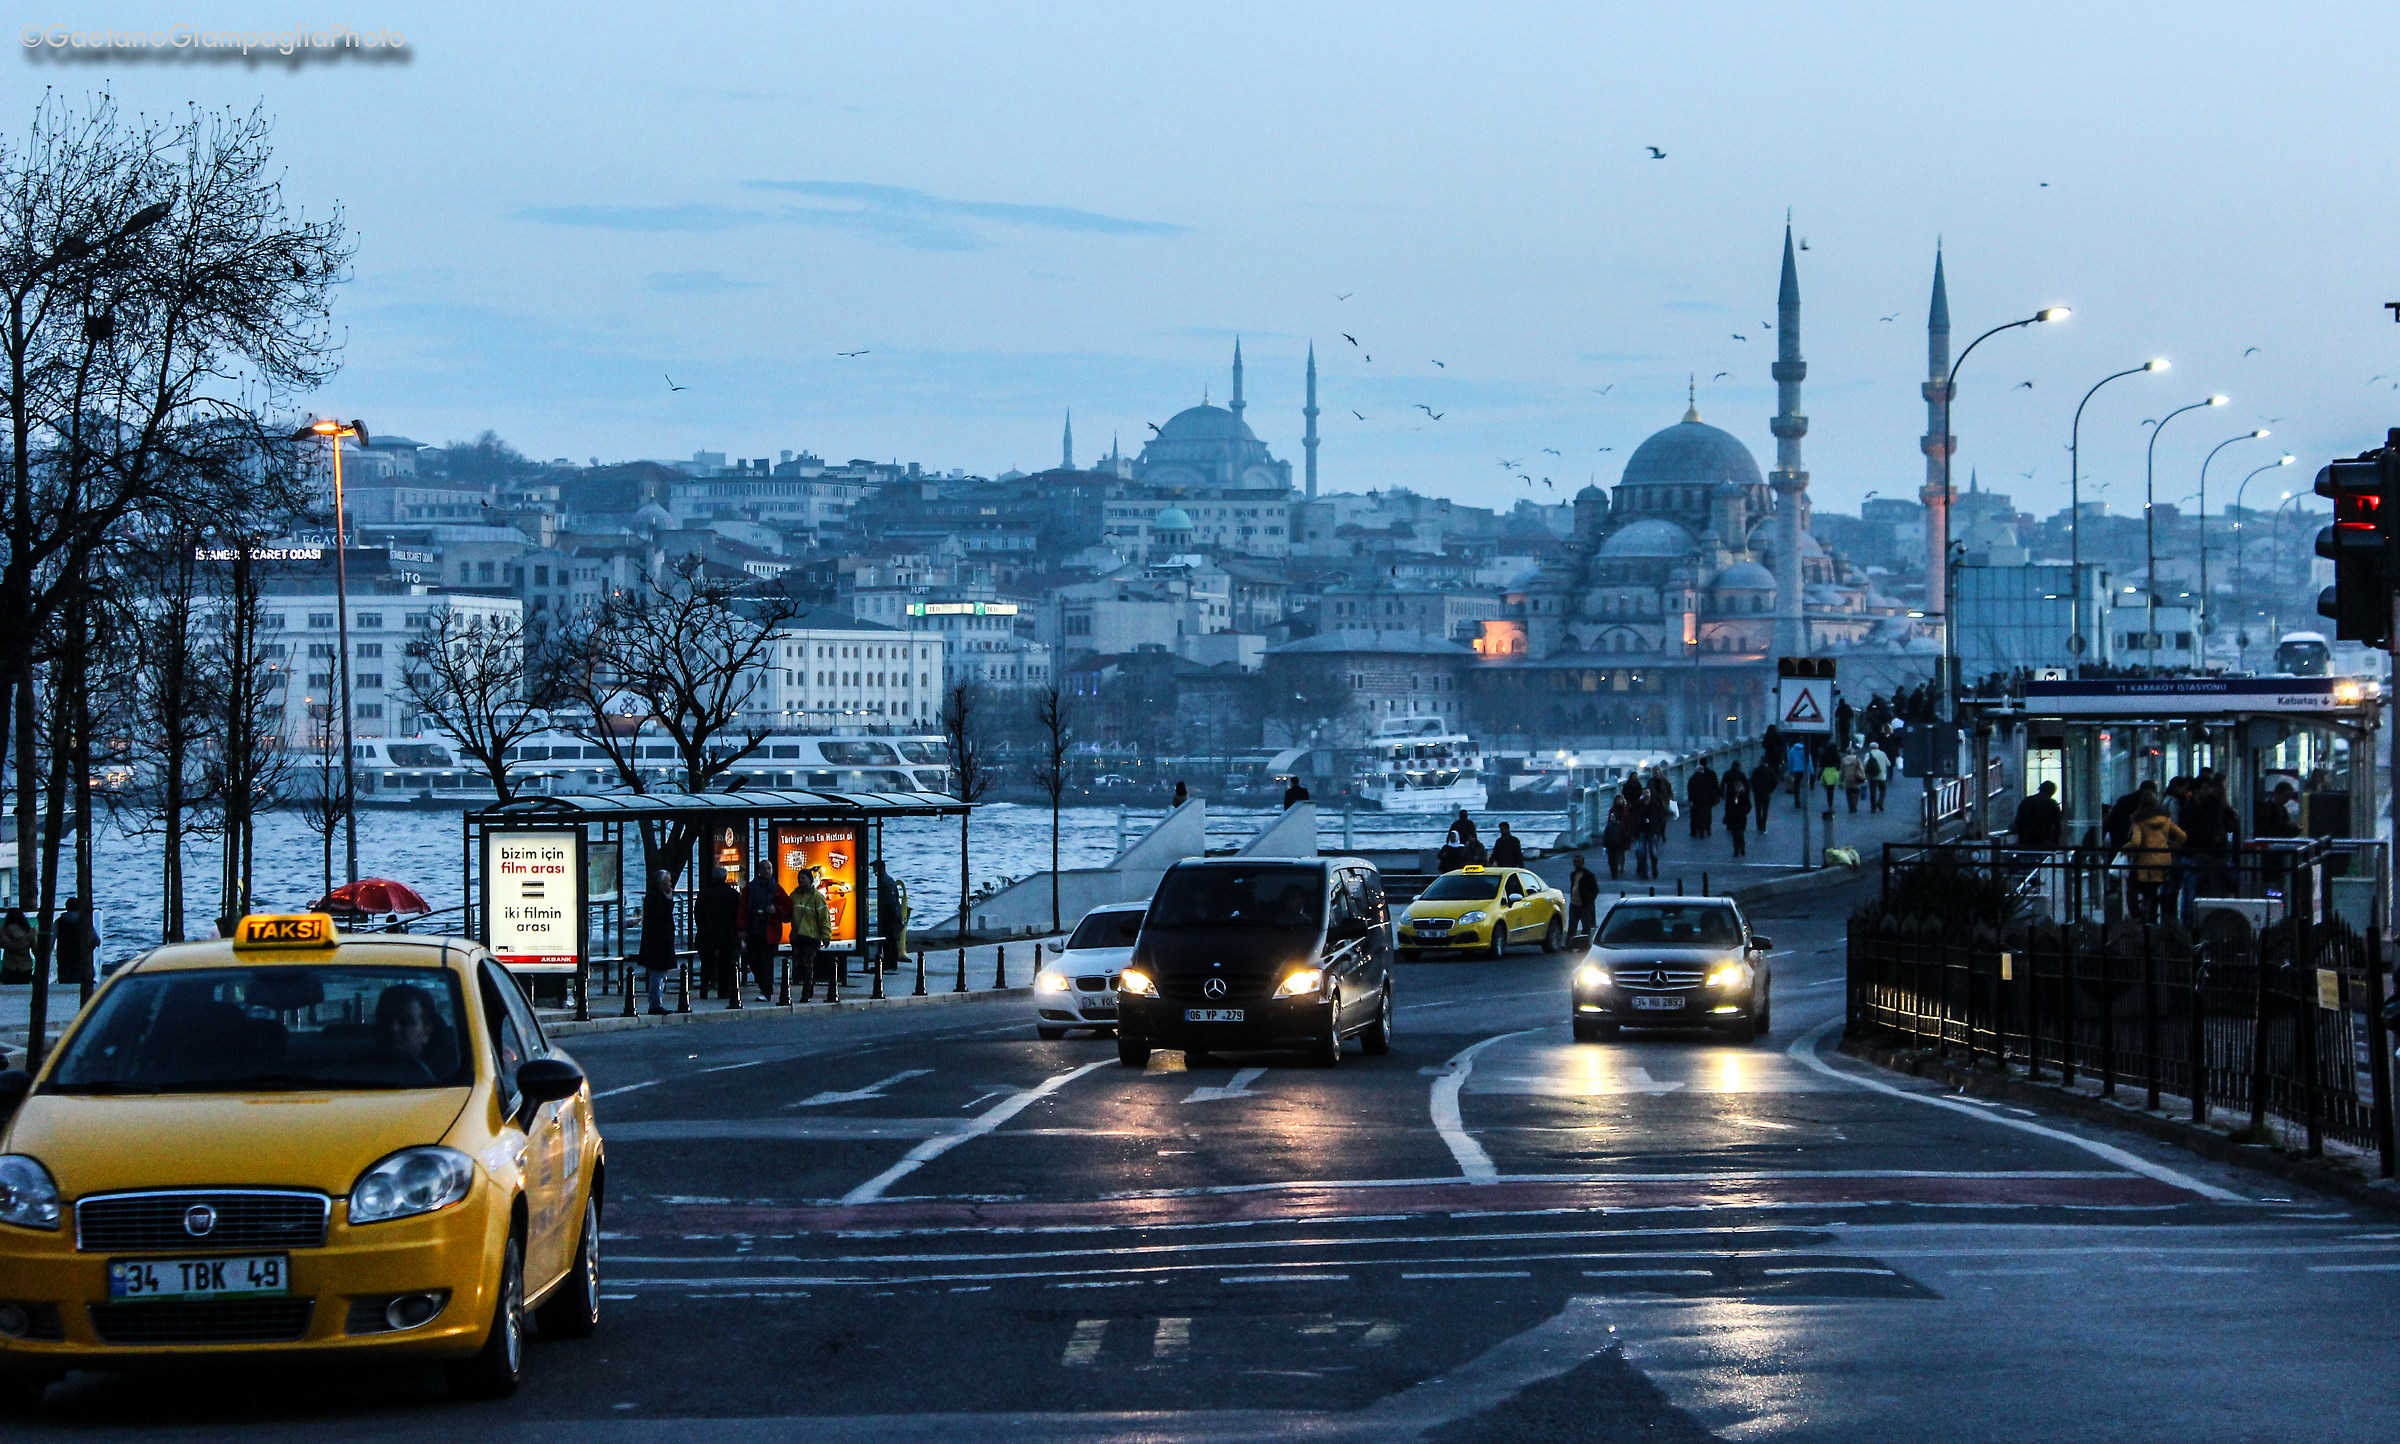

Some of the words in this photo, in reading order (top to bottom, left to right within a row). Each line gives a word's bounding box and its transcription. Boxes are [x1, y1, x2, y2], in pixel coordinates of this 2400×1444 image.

[301, 533, 352, 545] EGACY
[289, 549, 321, 560] ODASI
[401, 569, 420, 584] İTO
[816, 833, 825, 842] En
[501, 847, 537, 859] bizim
[541, 847, 564, 861] için
[501, 861, 527, 874] film
[531, 864, 565, 874] arası
[504, 907, 520, 918] iki
[524, 907, 562, 918] filmin
[516, 923, 550, 932] arası
[1190, 1011, 1201, 1020] 06
[1206, 1011, 1217, 1020] VP
[1226, 1011, 1242, 1020] 279
[127, 1264, 159, 1293] 34
[178, 1261, 226, 1291] TBK
[247, 1259, 279, 1288] 49
